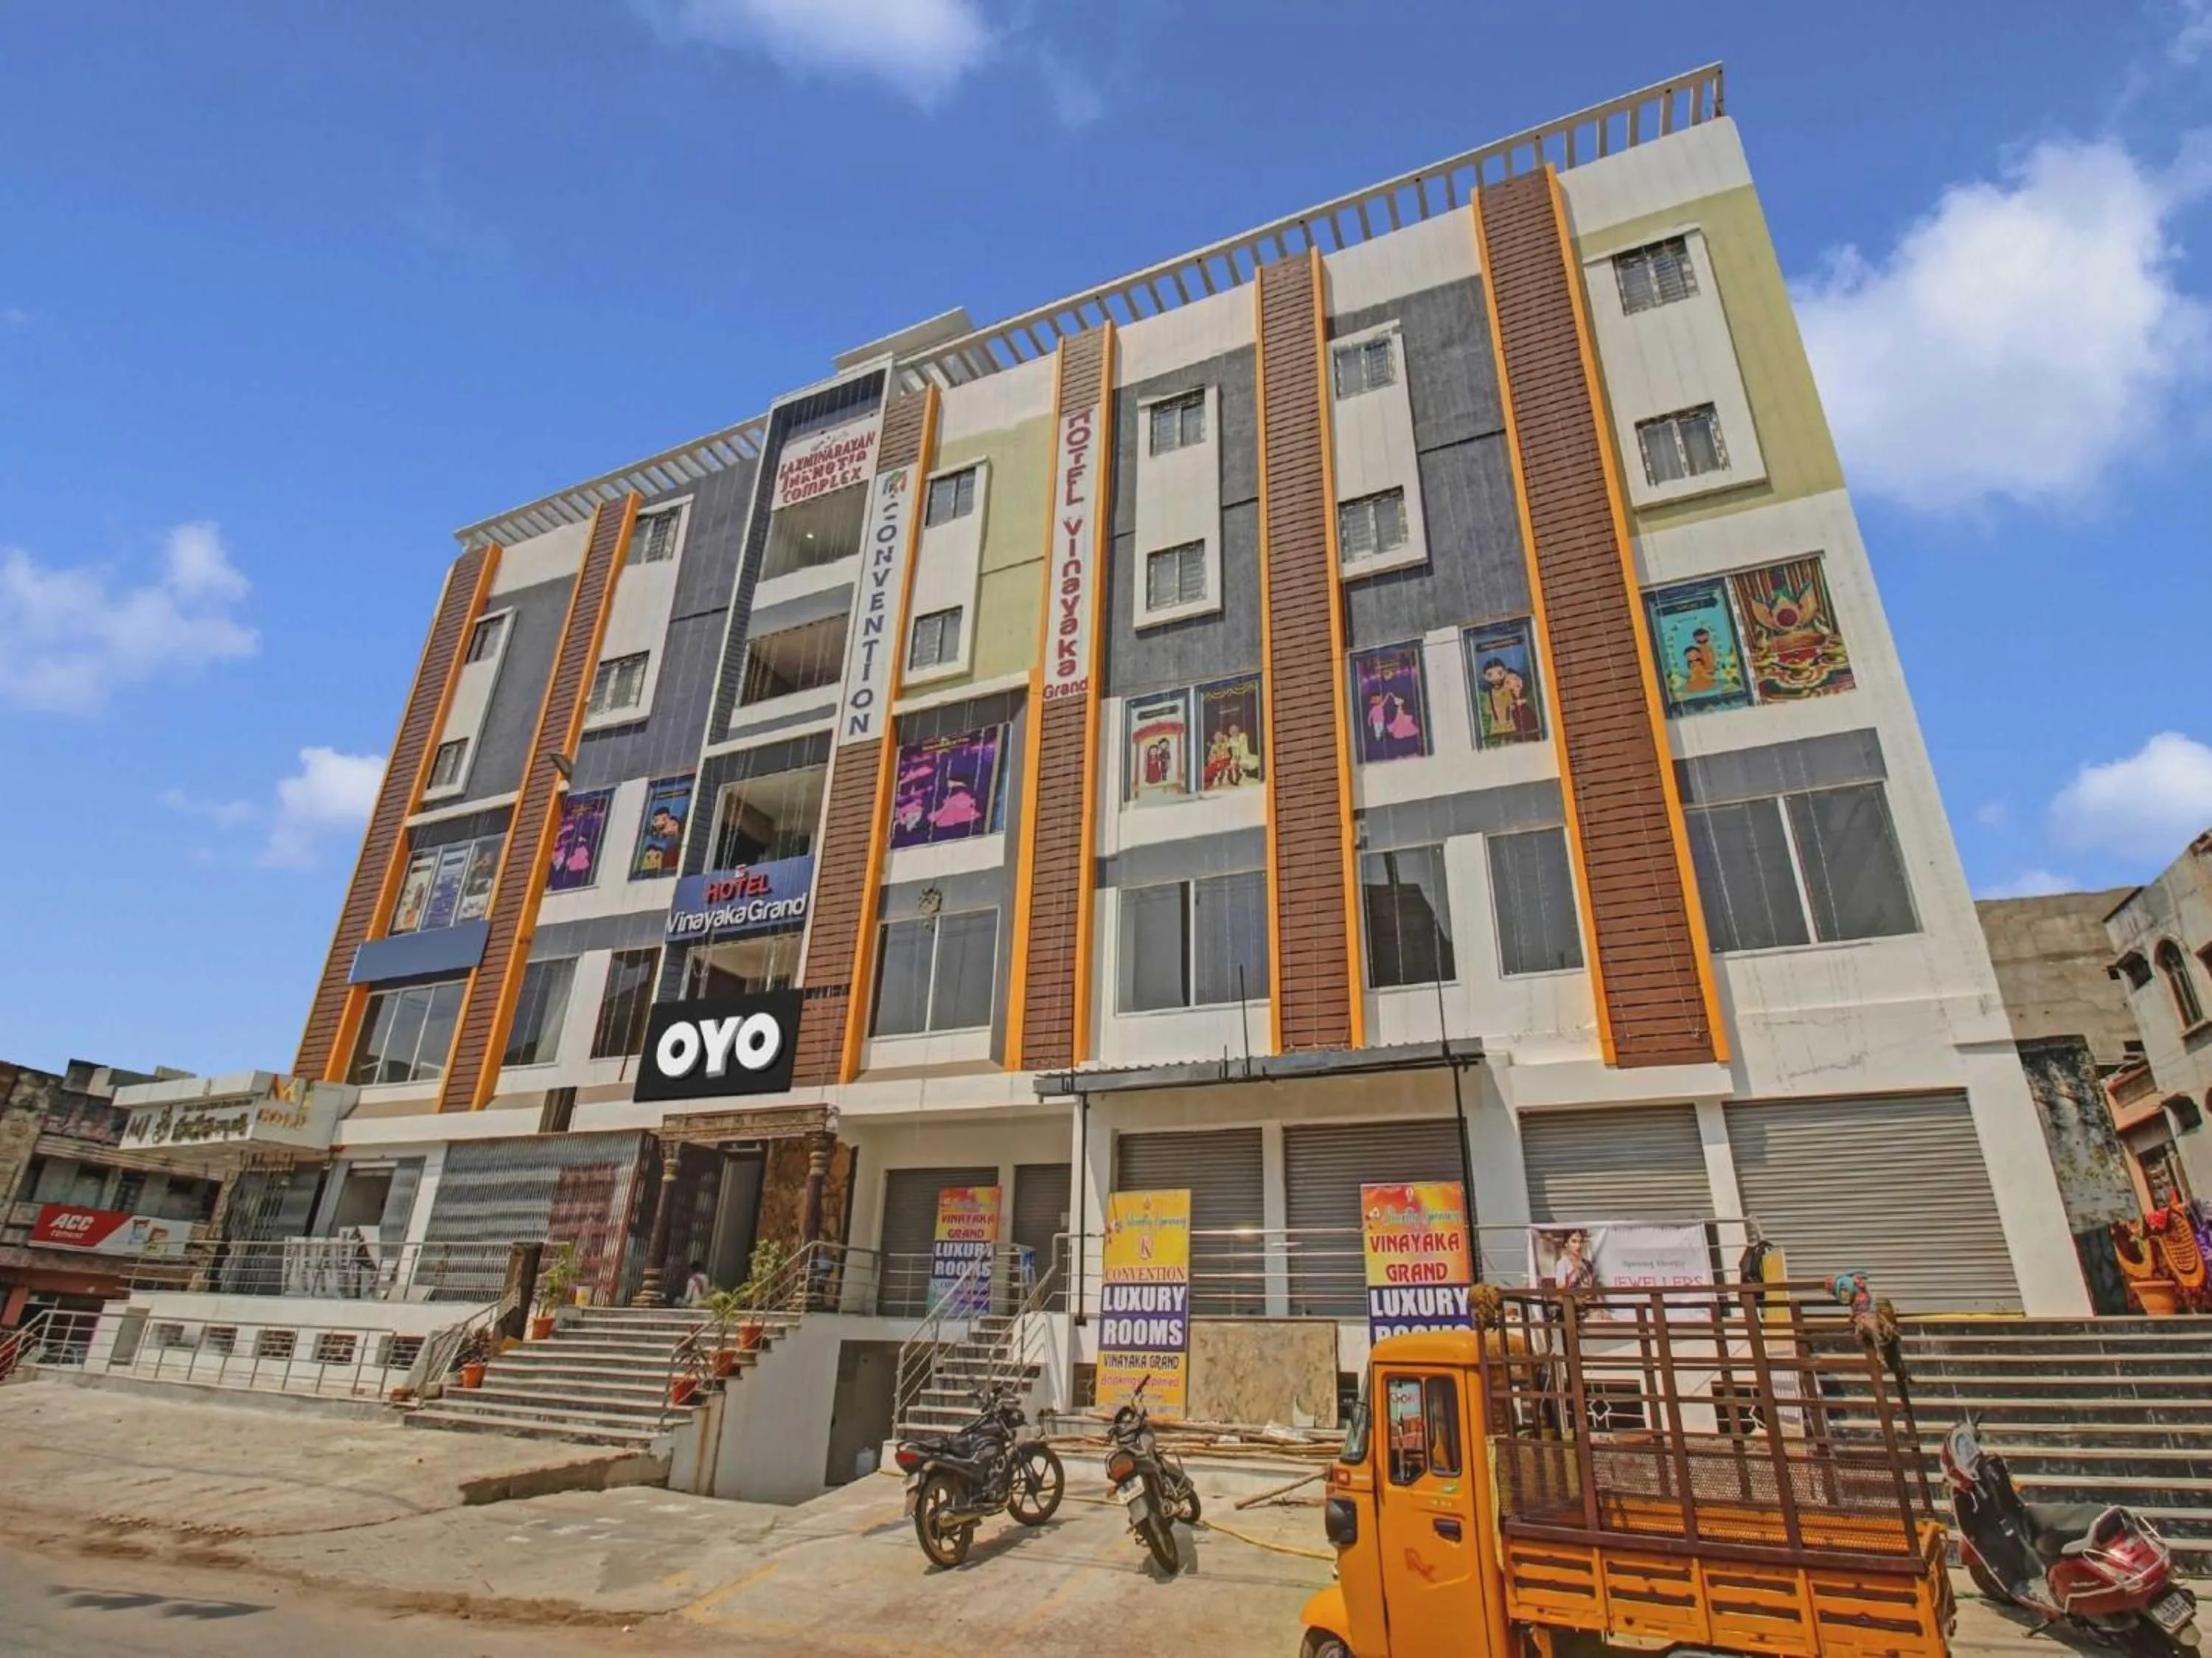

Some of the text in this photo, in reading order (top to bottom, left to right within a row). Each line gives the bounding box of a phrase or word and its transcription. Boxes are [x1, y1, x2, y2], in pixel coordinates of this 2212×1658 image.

[783, 466, 861, 503] COMPLEX
[849, 502, 899, 736] CONVENTION
[1043, 676, 1088, 698] Grand
[704, 874, 771, 903] HOTEL
[656, 1013, 782, 1078] OYO
[48, 1213, 94, 1231] ACC
[947, 1229, 984, 1239] GRAND
[1369, 1232, 1460, 1253] VINAYAKA
[1105, 1266, 1185, 1281] CONVENTION
[1386, 1262, 1449, 1283] GRAND
[1102, 1286, 1186, 1313] LUXURY
[1370, 1287, 1470, 1317] LUXURY
[1102, 1319, 1183, 1346] ROOMS
[1104, 1353, 1180, 1370] VINAYAKA GRAND
